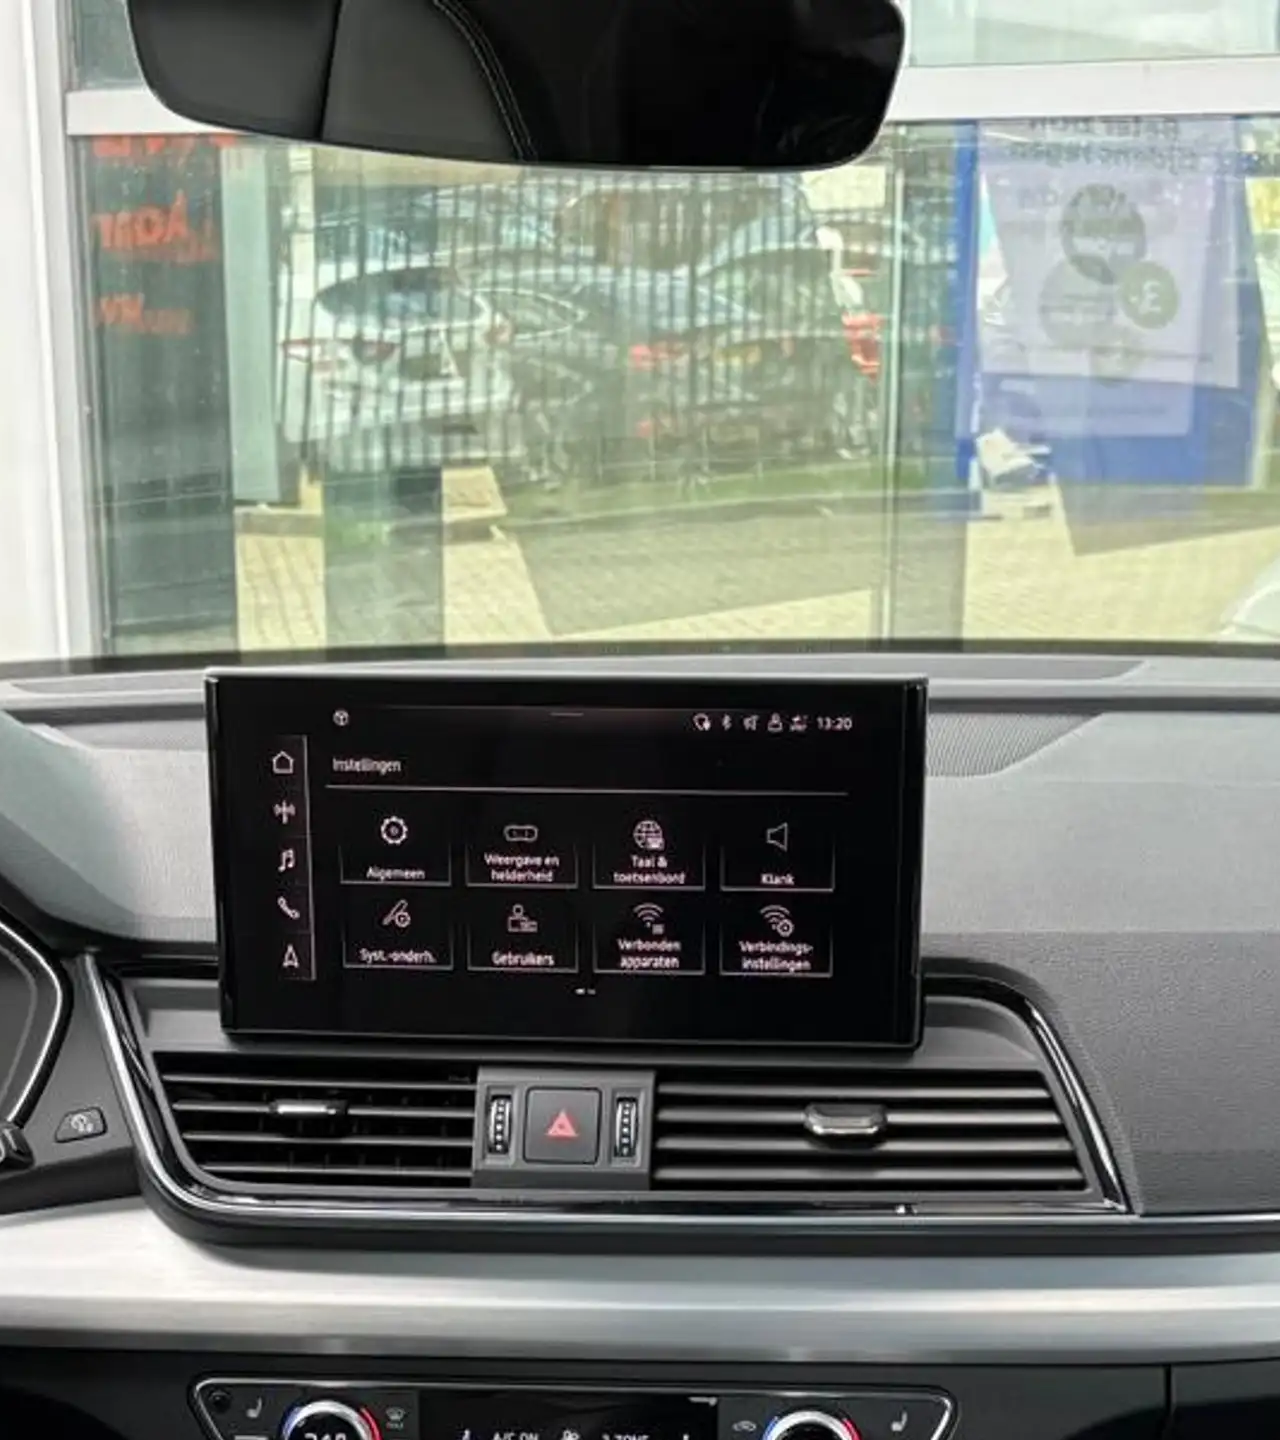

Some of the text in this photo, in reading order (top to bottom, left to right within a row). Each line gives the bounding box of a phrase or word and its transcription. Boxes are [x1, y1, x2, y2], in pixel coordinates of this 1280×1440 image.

[817, 717, 852, 731] 13:20
[332, 757, 401, 775] Instellingen
[484, 853, 559, 868] Weergave en
[631, 855, 655, 868] Taal
[366, 866, 425, 882] Algemeen
[491, 869, 553, 882] helderheid
[613, 872, 686, 885] toetsenbord
[761, 873, 795, 885] Klank
[617, 938, 681, 952] Verbonden
[738, 941, 813, 955] Verbindings-
[491, 951, 555, 966] Gebruikers
[620, 956, 680, 970] apparaten
[741, 957, 812, 973] instellingen
